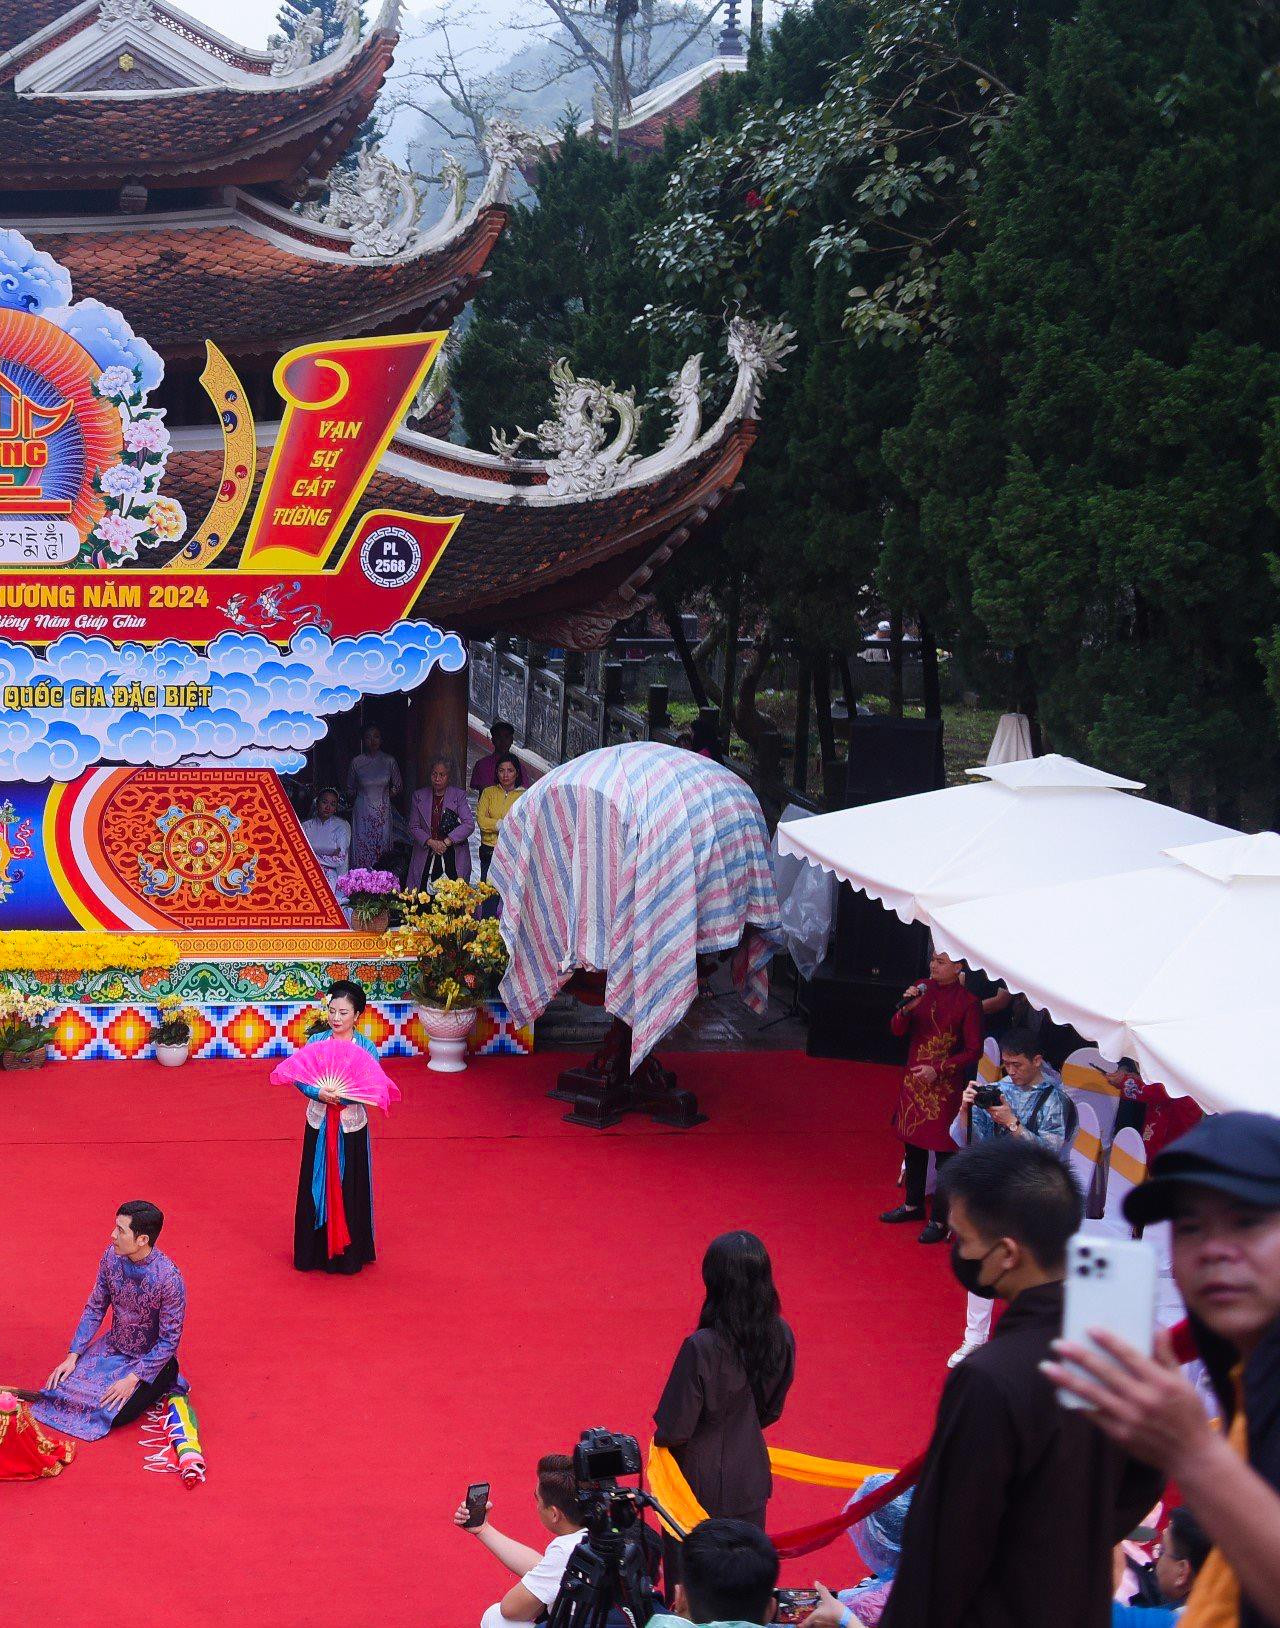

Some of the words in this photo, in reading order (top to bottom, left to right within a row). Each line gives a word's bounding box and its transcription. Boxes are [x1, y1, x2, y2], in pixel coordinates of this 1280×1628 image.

[317, 420, 363, 443] VẠN
[309, 447, 344, 472] SỰ
[291, 476, 337, 497] CÁT
[272, 506, 333, 526] TƯỜNG
[383, 541, 399, 556] PL
[374, 559, 406, 573] 2568
[83, 580, 141, 608] NĂM
[148, 585, 210, 608] 2024
[34, 614, 71, 629] Năm
[74, 614, 109, 631] Giáp
[112, 614, 147, 629] Thìn
[3, 678, 65, 712] QUỐC
[70, 685, 110, 709] GIA
[111, 680, 159, 713] ĐẶC
[163, 680, 214, 713] BIỆT
